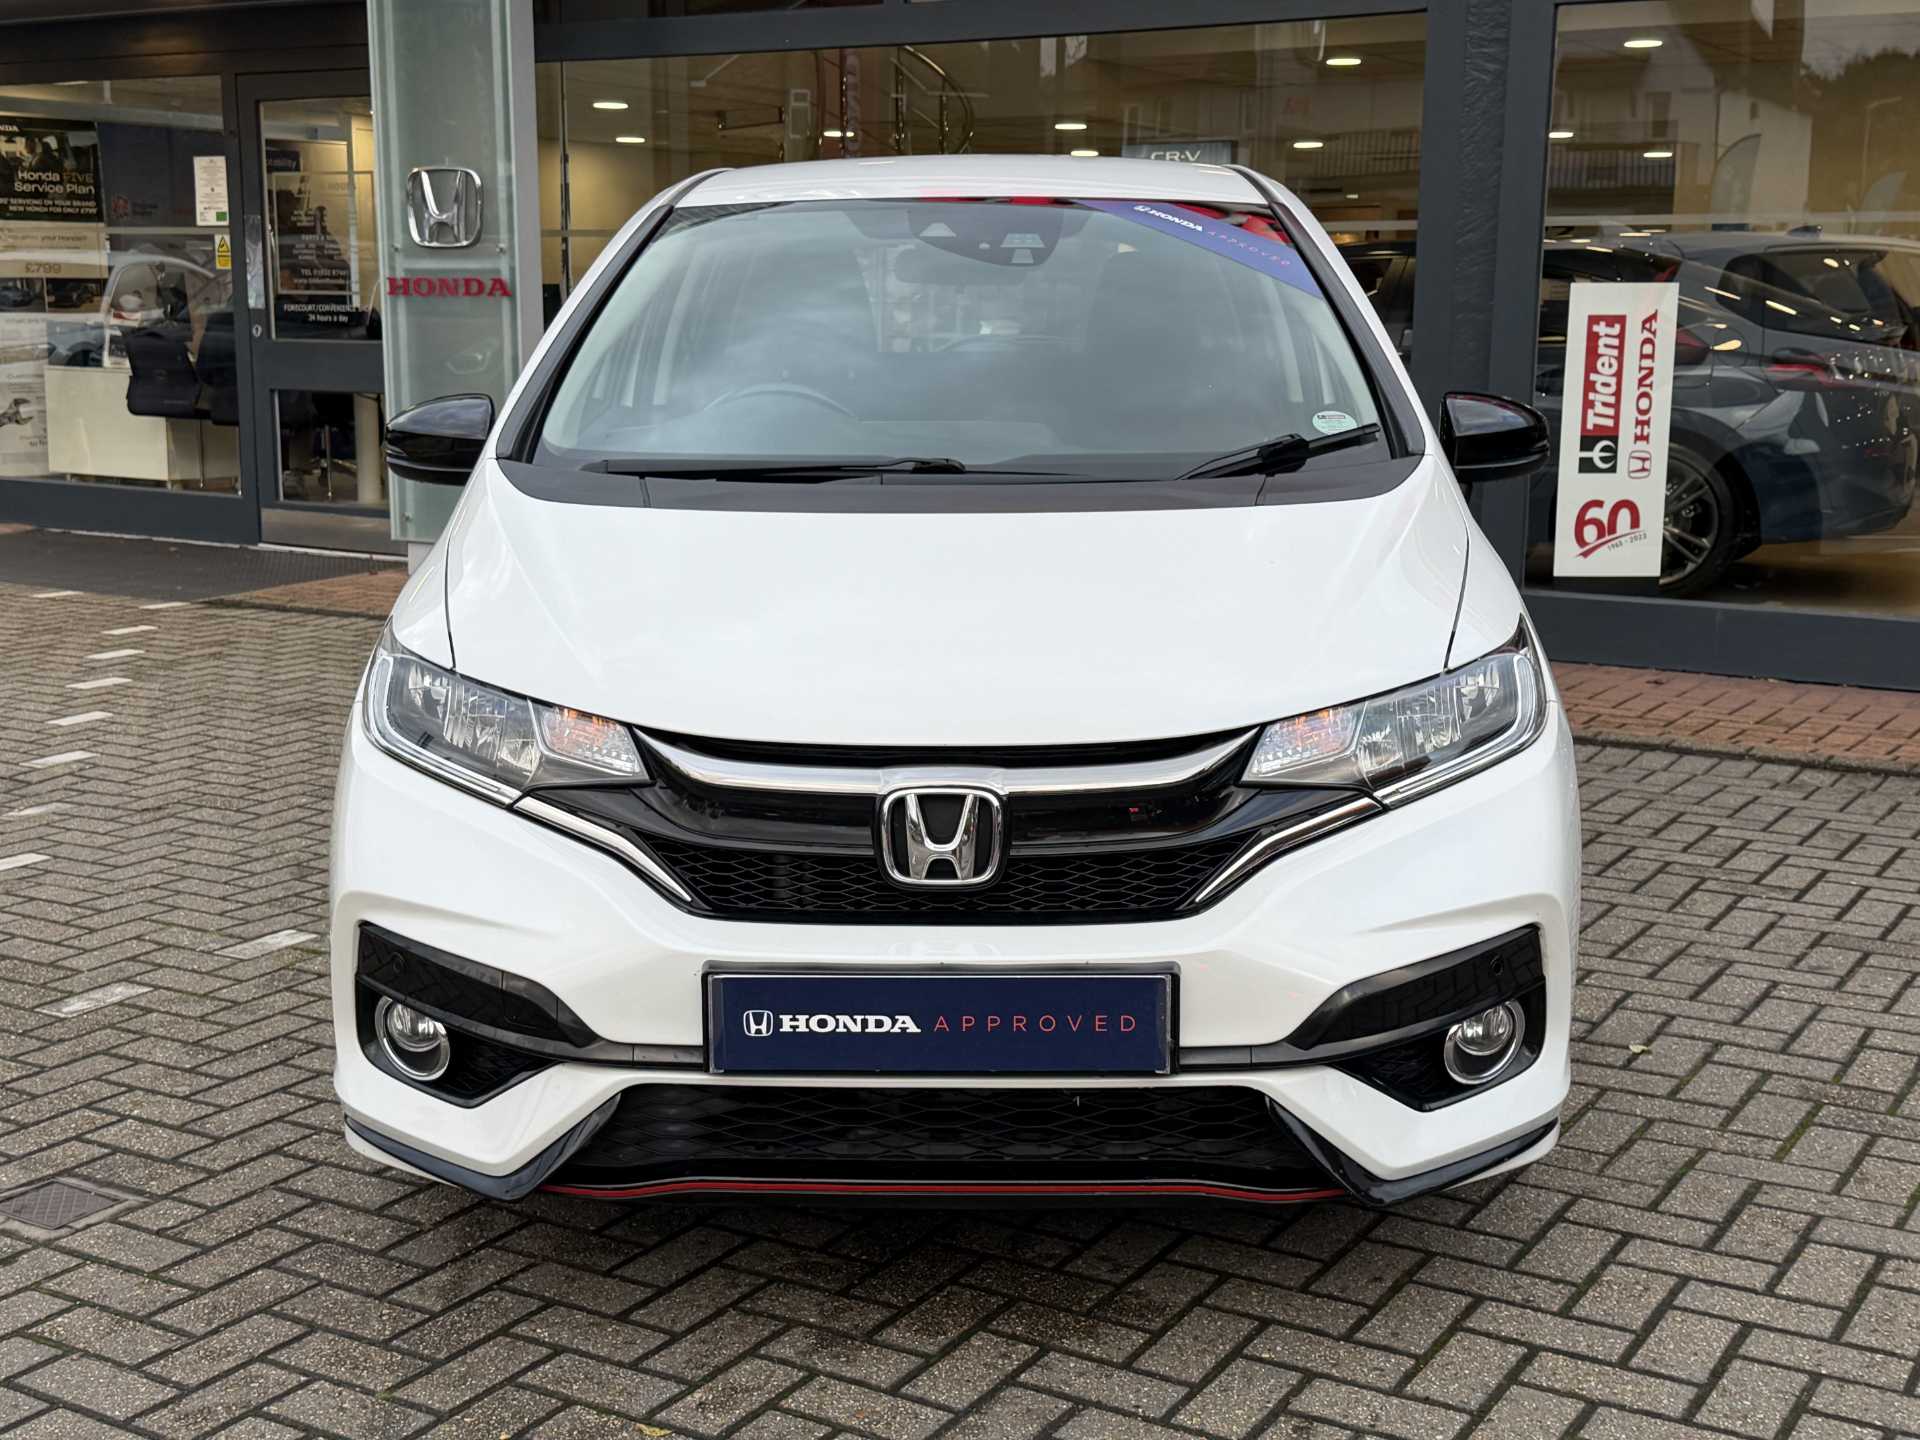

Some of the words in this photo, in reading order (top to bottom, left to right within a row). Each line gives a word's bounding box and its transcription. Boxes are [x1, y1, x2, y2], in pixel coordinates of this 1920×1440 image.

[0, 124, 19, 132] NDA
[18, 170, 60, 182] Honda
[14, 181, 64, 193] Service
[66, 183, 95, 195] Plan
[1147, 208, 1203, 232] HONDA
[1207, 230, 1291, 266] APPROVED
[25, 263, 62, 273] £799
[387, 277, 512, 297] HONDA
[1586, 320, 1621, 431] Trident
[1634, 309, 1658, 444] HONDA
[779, 1014, 921, 1033] HONDA
[933, 1015, 1136, 1032] APPROVED
